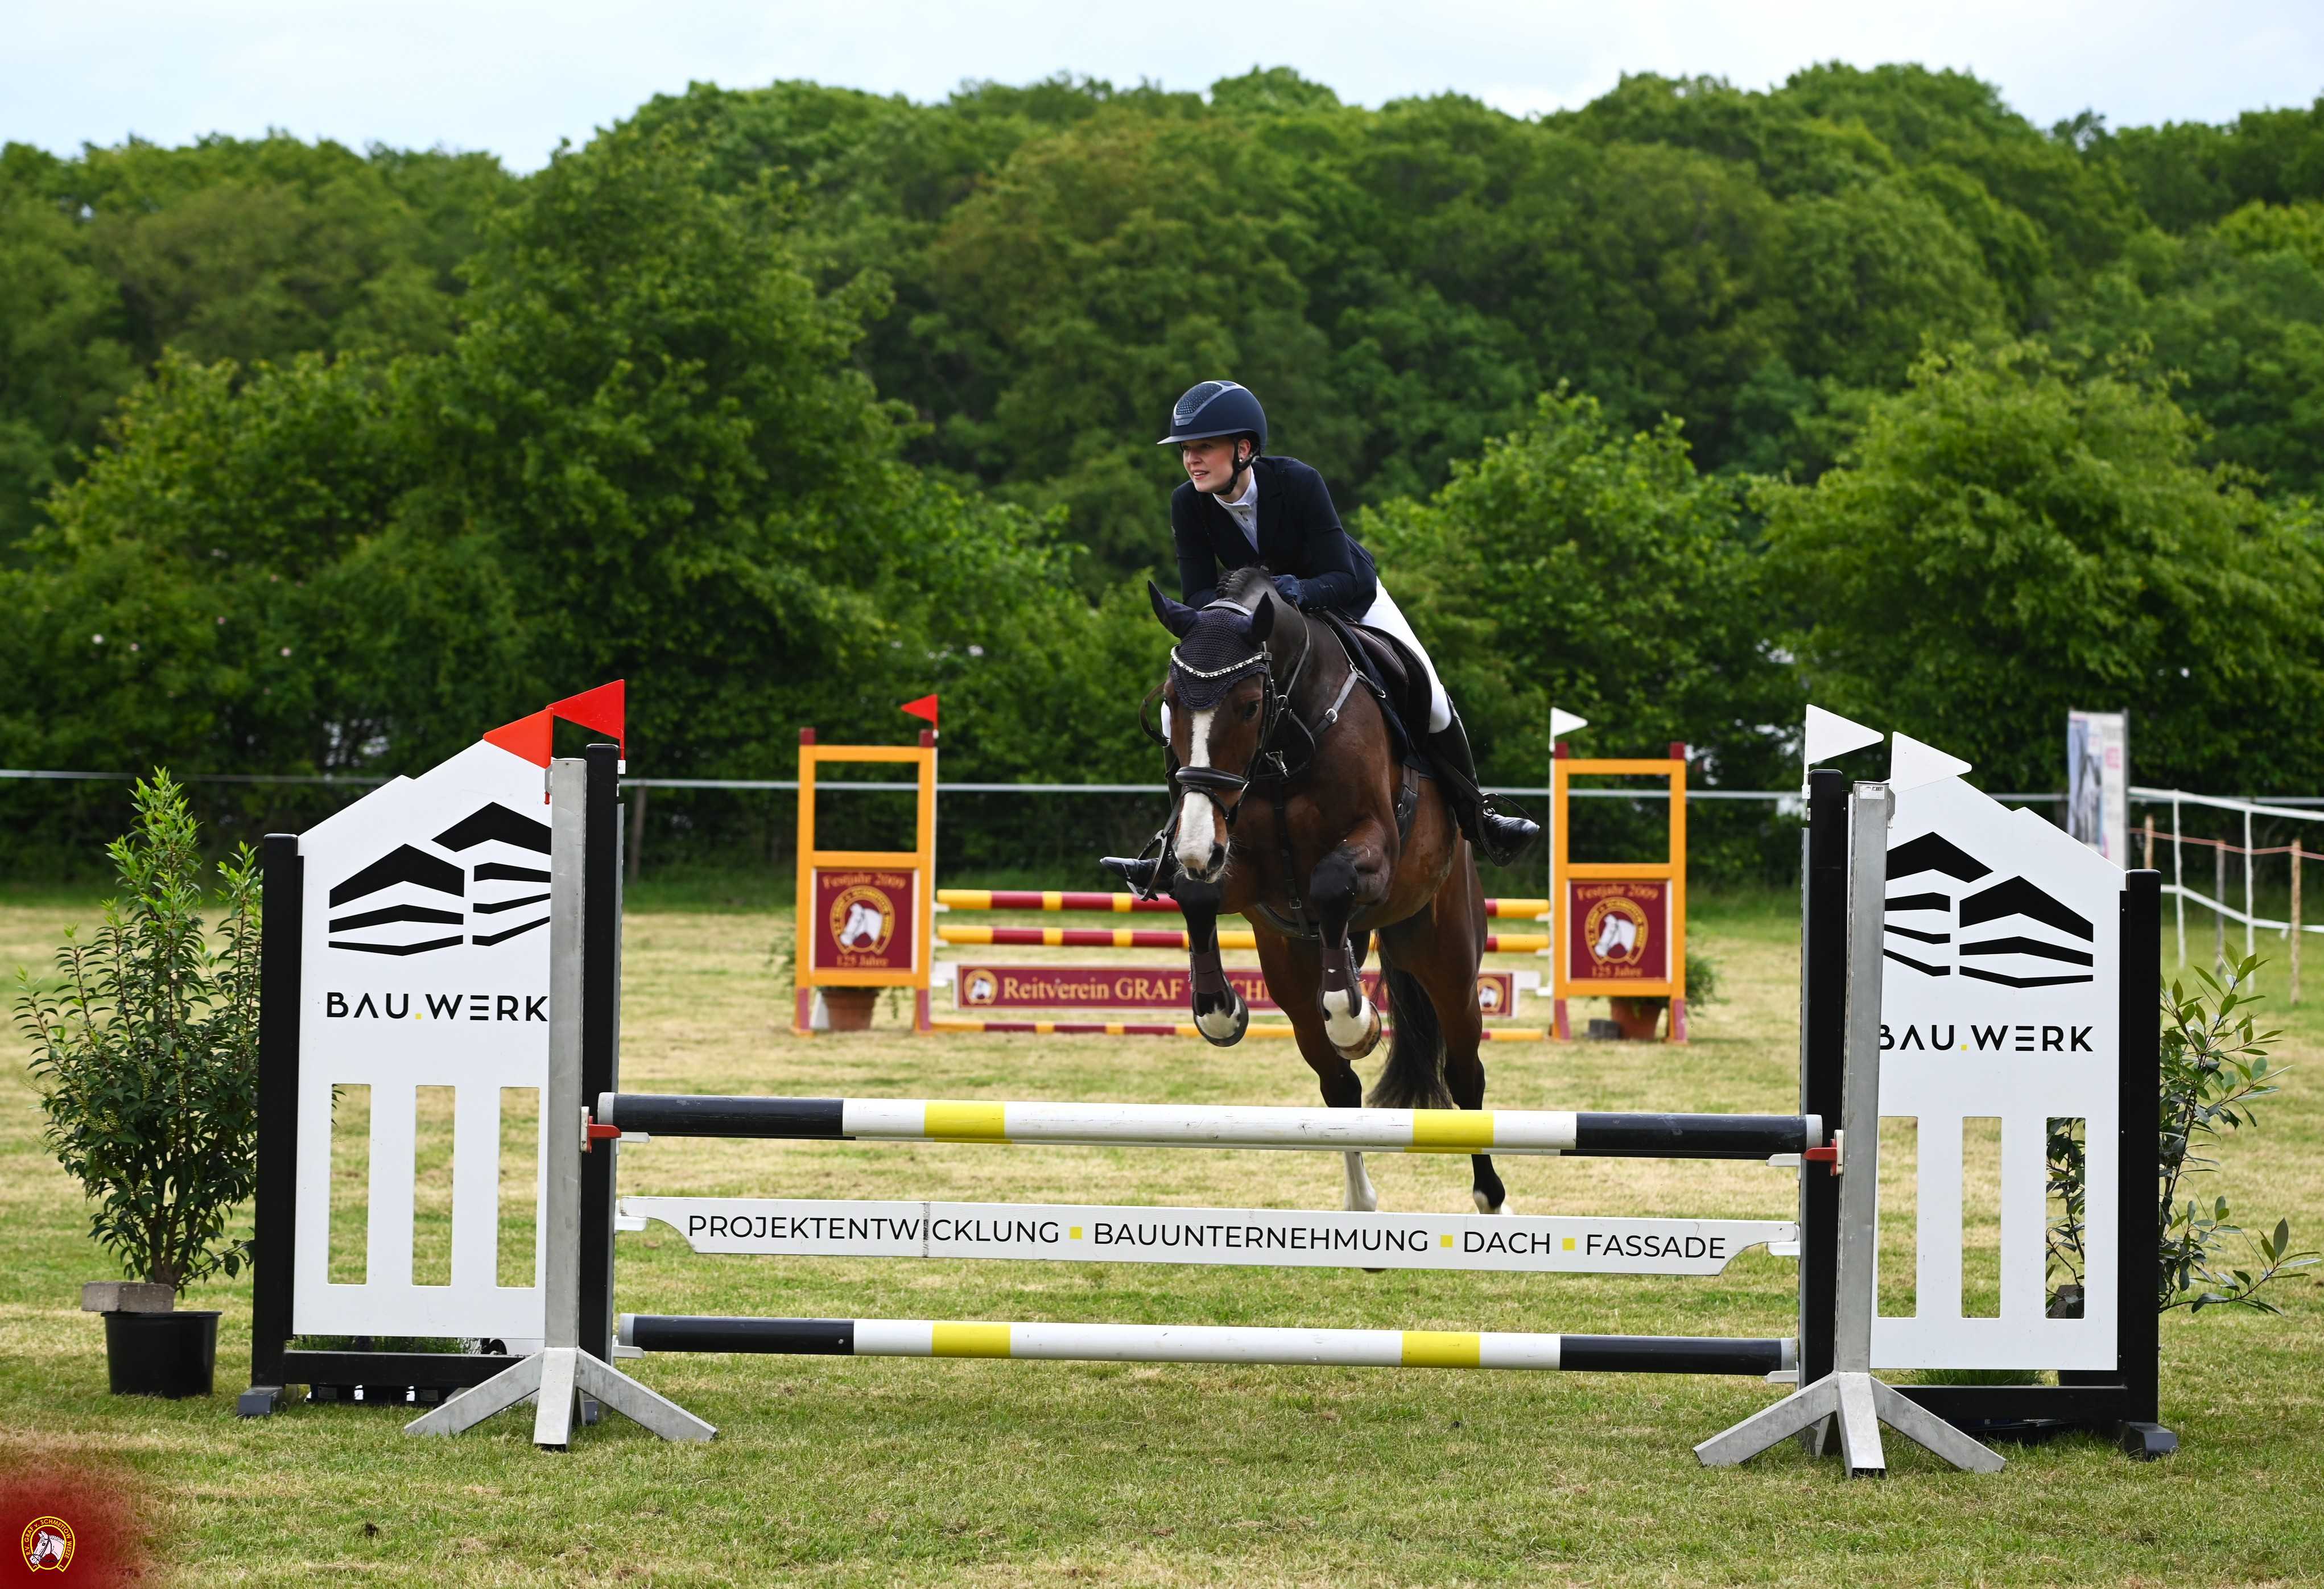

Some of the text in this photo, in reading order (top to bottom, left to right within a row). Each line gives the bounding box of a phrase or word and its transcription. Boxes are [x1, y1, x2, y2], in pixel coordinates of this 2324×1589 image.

[836, 954, 889, 967] 125 Jahre
[1591, 965, 1644, 978] 125 Jahre
[1003, 977, 1184, 1001] Reitverein GRAF
[1095, 1223, 1429, 1252] BAUUNTERNEHMUNG
[1464, 1231, 1550, 1254] DACH
[1587, 1234, 1726, 1259] FASSADE
